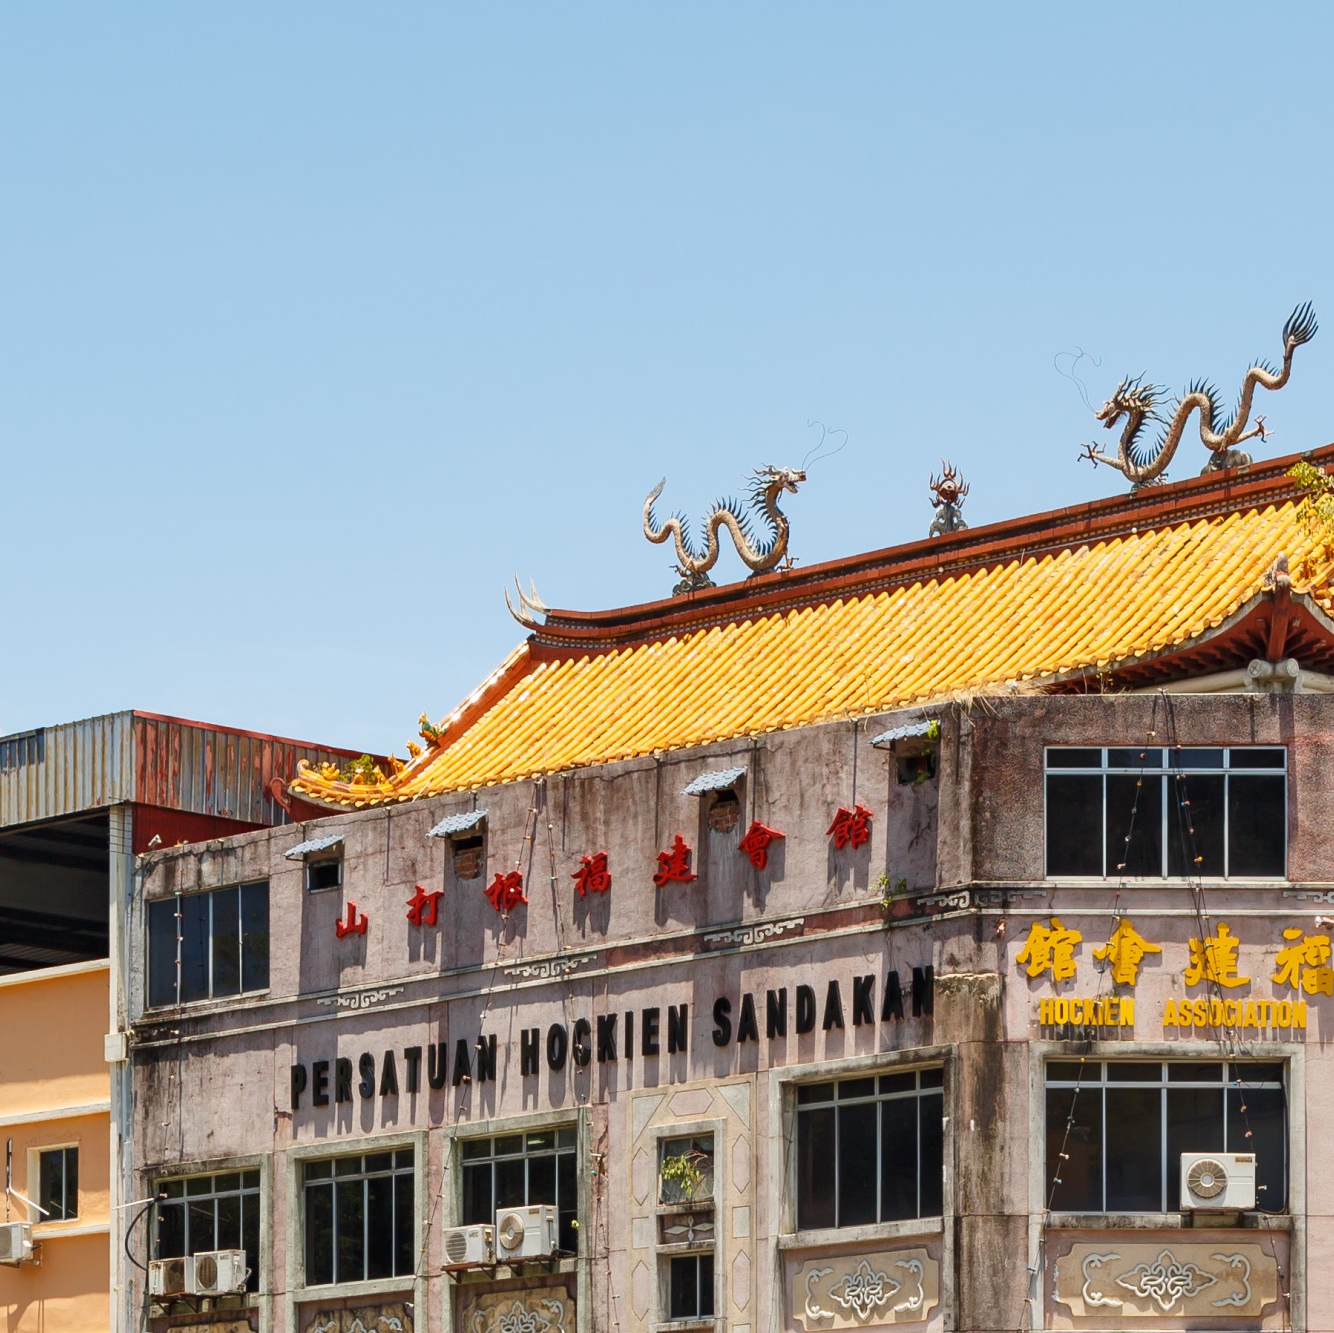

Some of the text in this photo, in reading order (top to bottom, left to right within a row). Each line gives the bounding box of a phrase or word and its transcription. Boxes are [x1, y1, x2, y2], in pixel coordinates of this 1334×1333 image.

[291, 965, 934, 1110] PERSATUAN HOCKIEN SANDAKAN
[1039, 997, 1307, 1028] HOCKIEN ASSOCIATION
